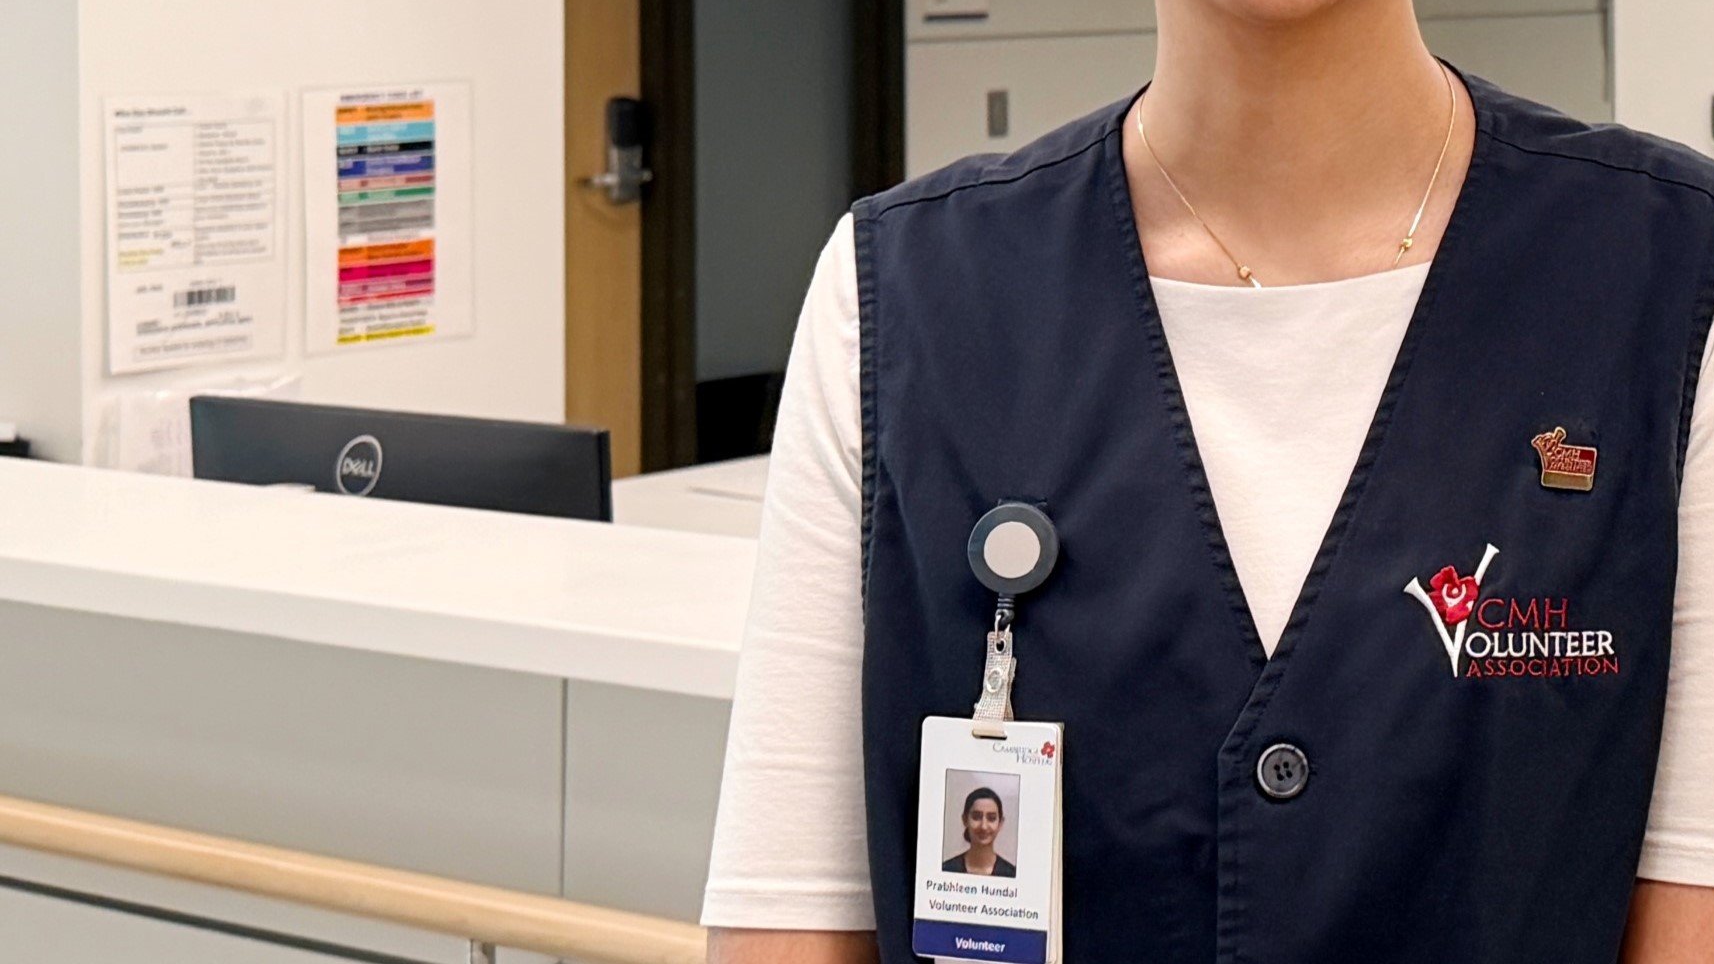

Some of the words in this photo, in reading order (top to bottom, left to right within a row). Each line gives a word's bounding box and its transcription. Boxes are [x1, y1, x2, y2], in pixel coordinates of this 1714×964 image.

[342, 456, 375, 477] DELL
[1477, 597, 1568, 629] CMH
[1466, 656, 1620, 678] ASSOCIATION
[981, 885, 1018, 898] Hundal
[929, 899, 978, 914] Volunteer
[981, 905, 1039, 919] Association
[955, 937, 1005, 952] Volunteer
